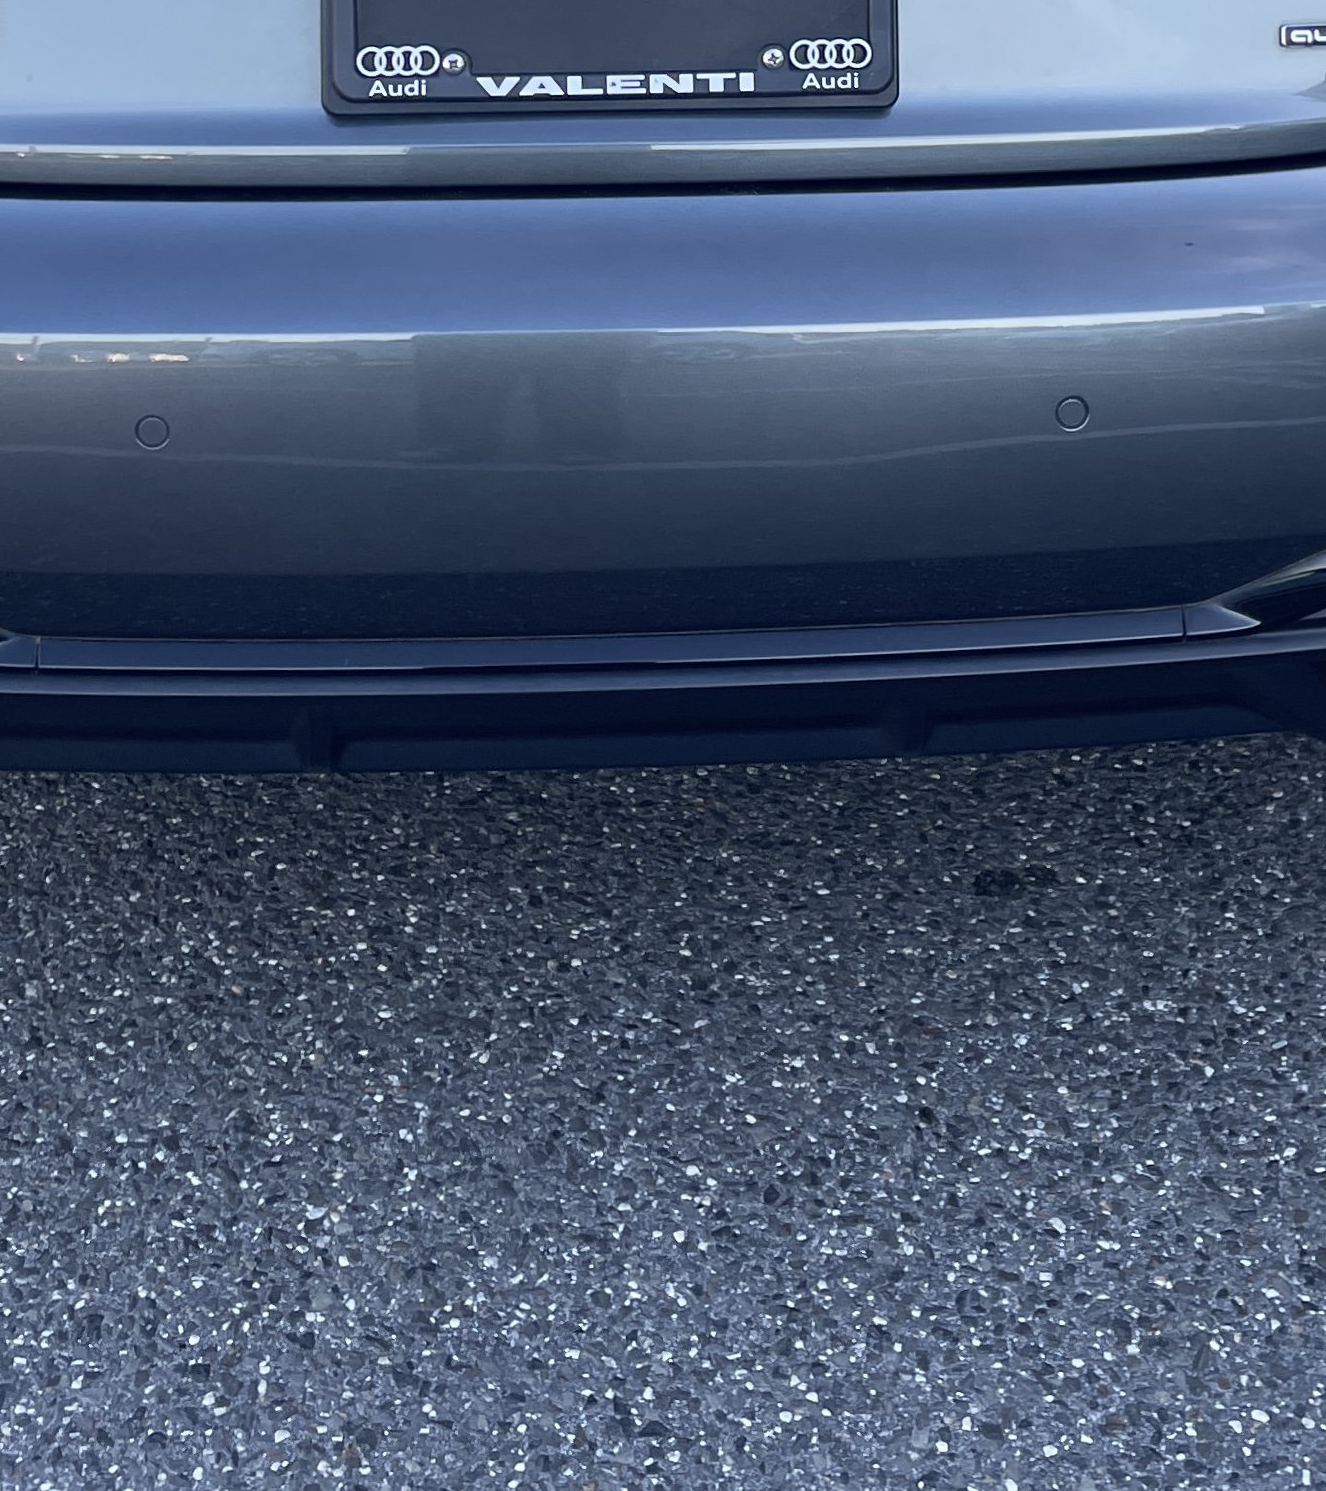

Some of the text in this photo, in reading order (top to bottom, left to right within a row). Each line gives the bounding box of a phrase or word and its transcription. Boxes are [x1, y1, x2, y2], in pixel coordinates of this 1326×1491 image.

[368, 79, 427, 97] Audi
[476, 72, 755, 97] VALENTI
[802, 72, 860, 90] Audi
